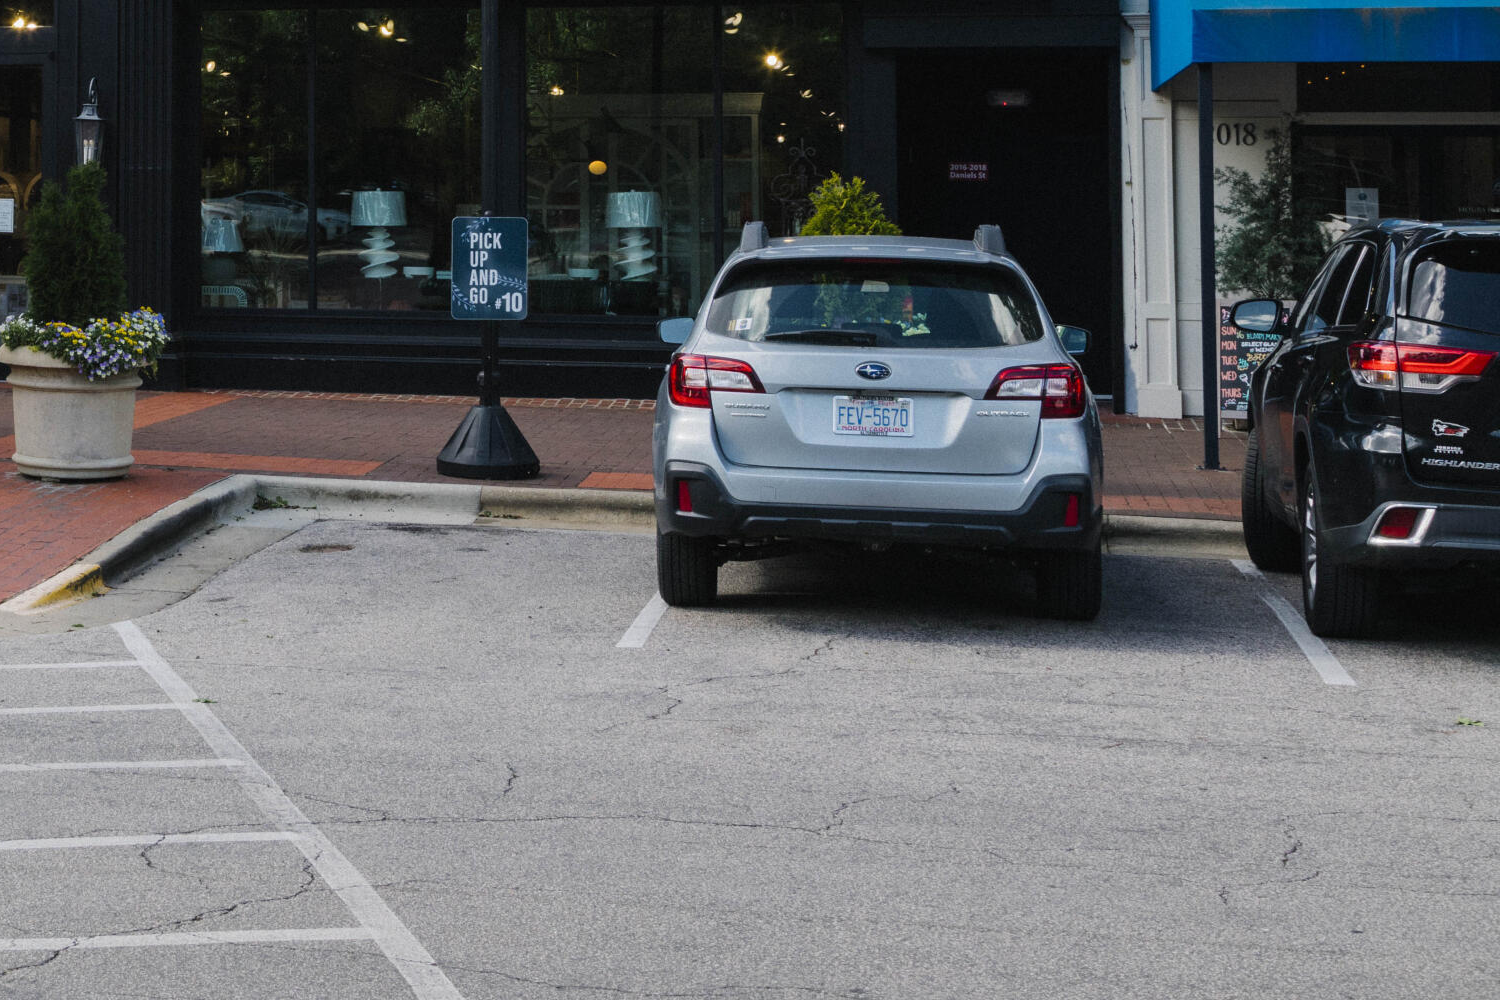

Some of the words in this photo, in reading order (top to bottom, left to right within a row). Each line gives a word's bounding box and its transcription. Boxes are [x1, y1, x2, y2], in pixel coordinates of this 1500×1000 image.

[1213, 122, 1256, 146] 018
[470, 232, 502, 250] PICK
[470, 250, 489, 268] UP
[469, 269, 499, 286] AND
[470, 287, 489, 305] GO
[495, 291, 523, 312] #10
[1221, 326, 1237, 336] SUN
[1221, 340, 1237, 350] MON
[1220, 355, 1238, 366] TUES
[1221, 371, 1237, 381] WED
[1220, 387, 1242, 399] THURS
[838, 406, 908, 427] FEV-5670
[1421, 457, 1500, 470] HIGHLANDER
